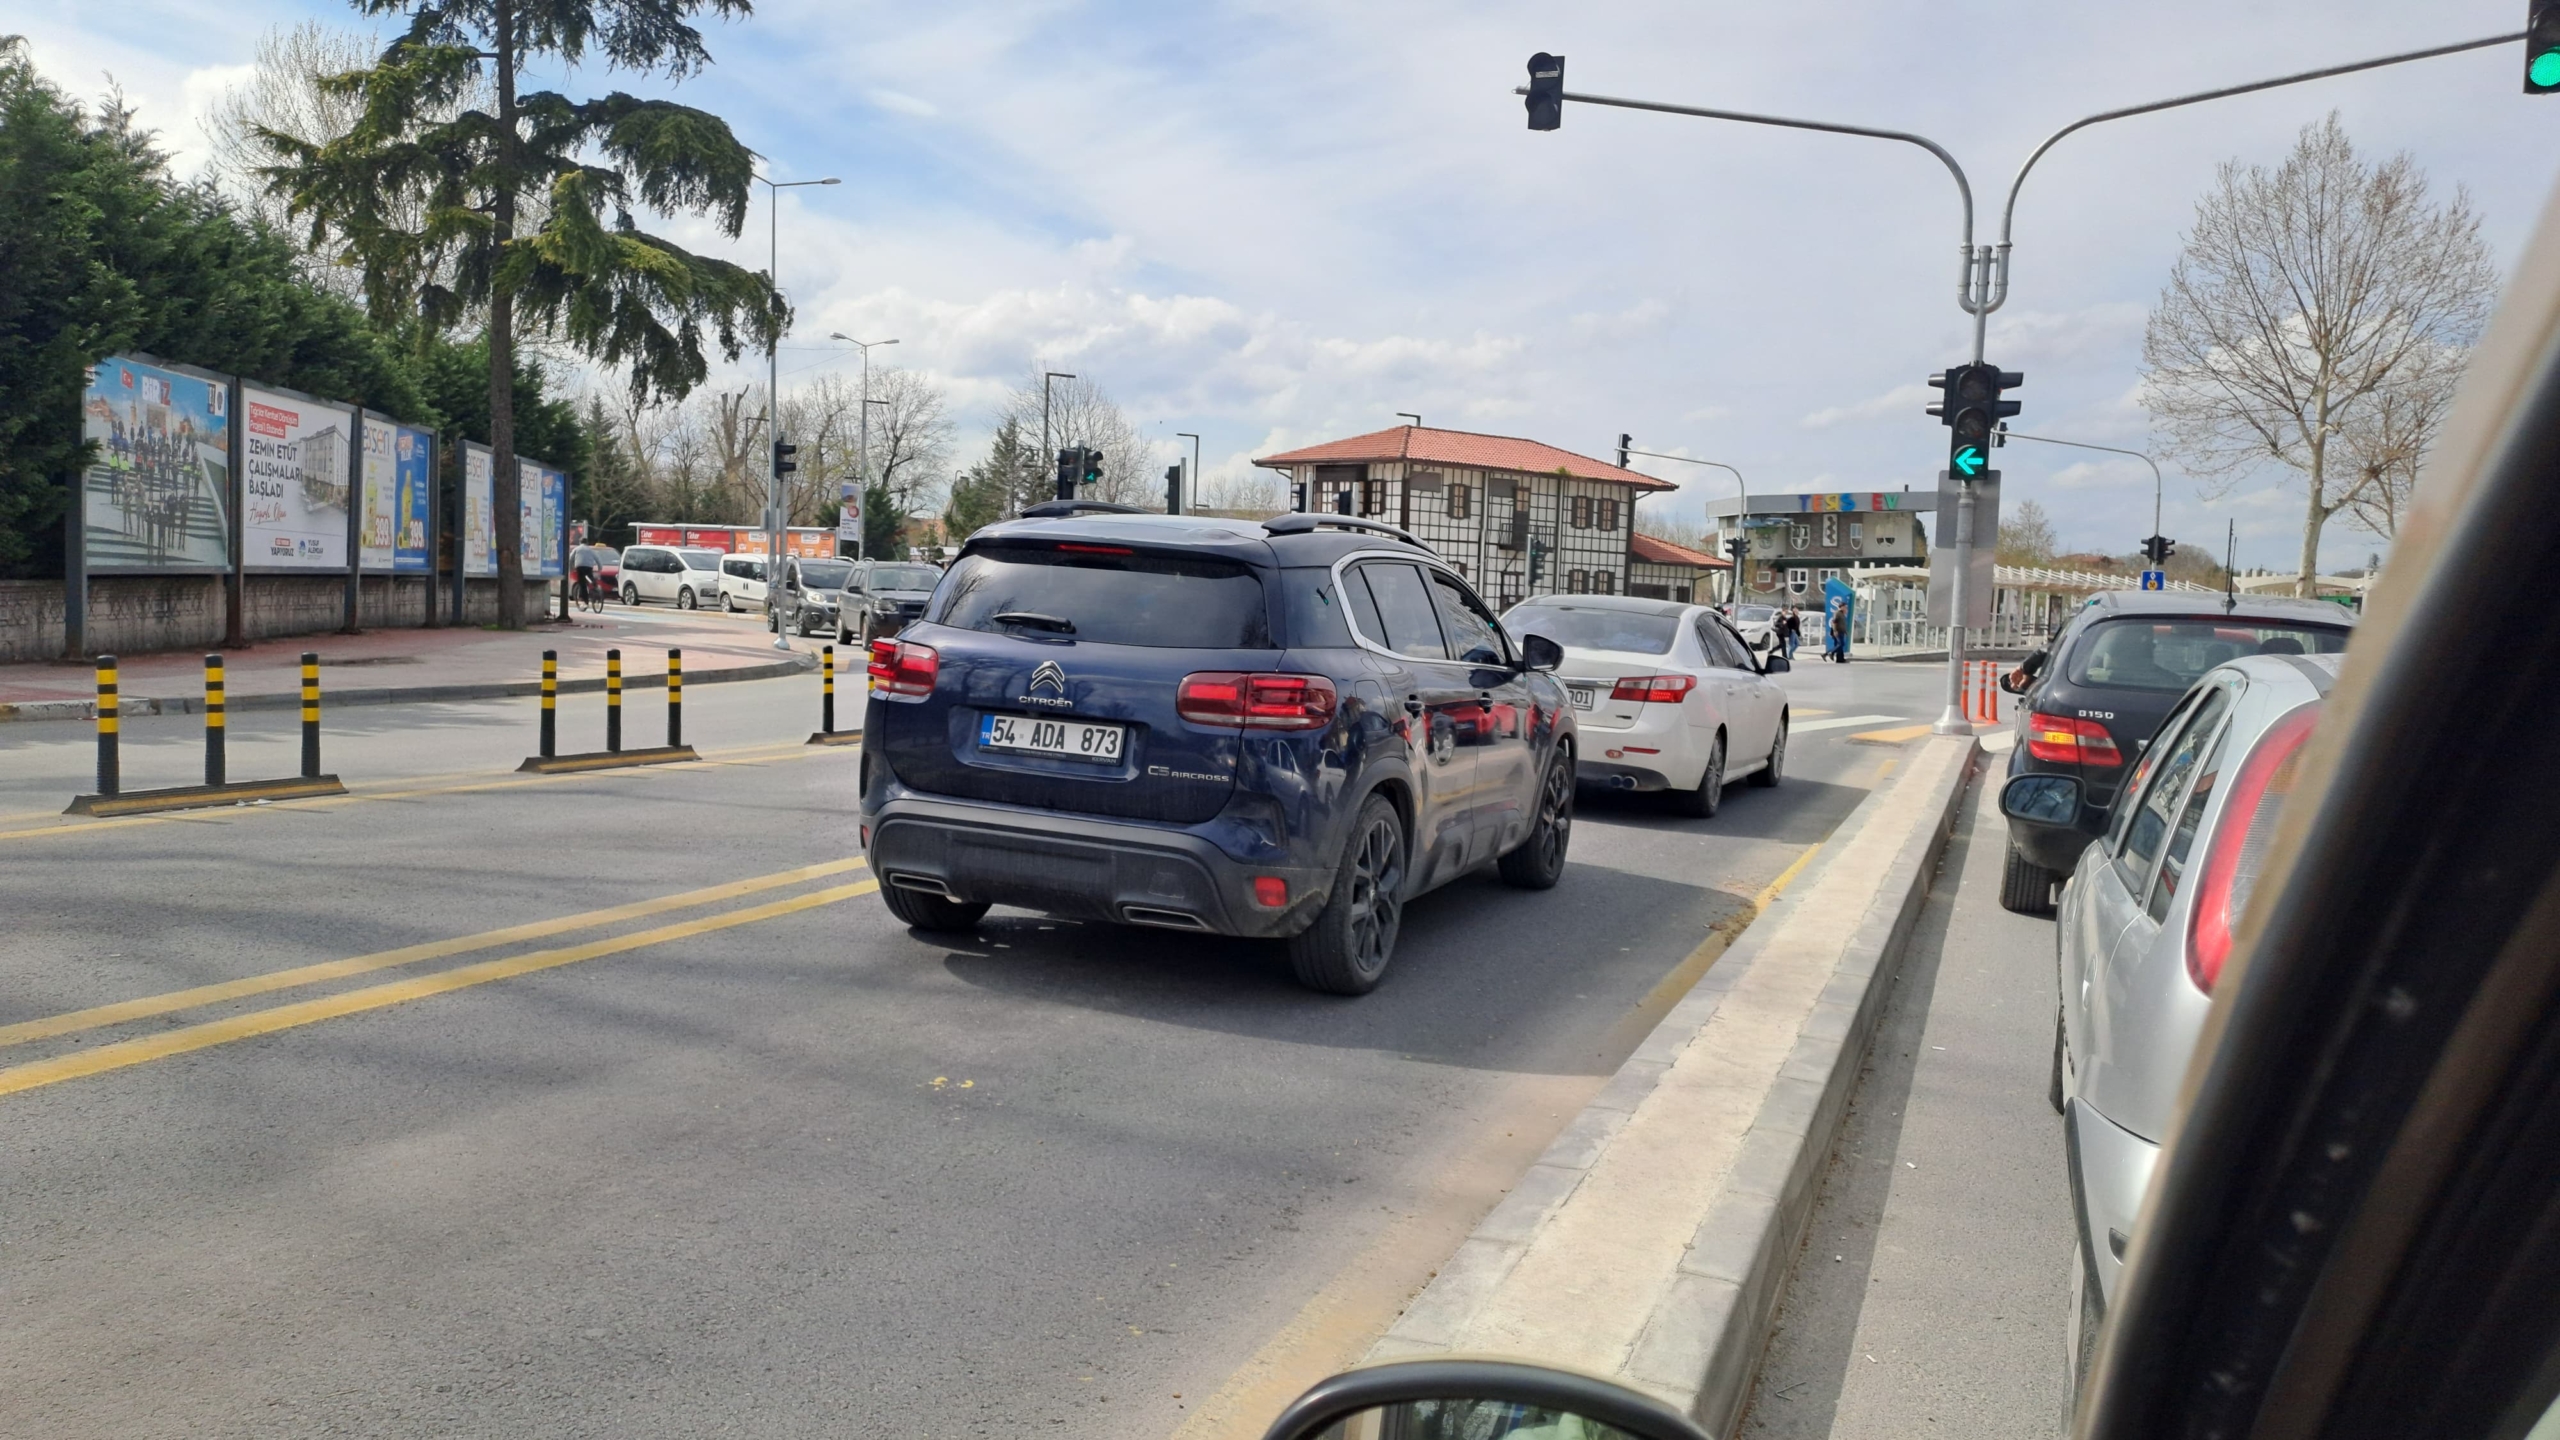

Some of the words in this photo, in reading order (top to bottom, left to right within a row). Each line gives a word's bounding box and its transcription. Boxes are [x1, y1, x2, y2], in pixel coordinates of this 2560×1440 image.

[249, 438, 275, 458] ZEMİN
[276, 443, 297, 461] ETÜT
[249, 459, 303, 482] ÇALIŞMALARI
[249, 479, 284, 500] BAŞLADI
[1798, 493, 1856, 512] TERS
[1871, 493, 1899, 511] EV
[981, 731, 991, 740] TR
[992, 718, 1015, 745] 54
[1030, 722, 1065, 750] ADA
[1080, 727, 1119, 755] 873
[1171, 771, 1230, 782] AIRCROSS
